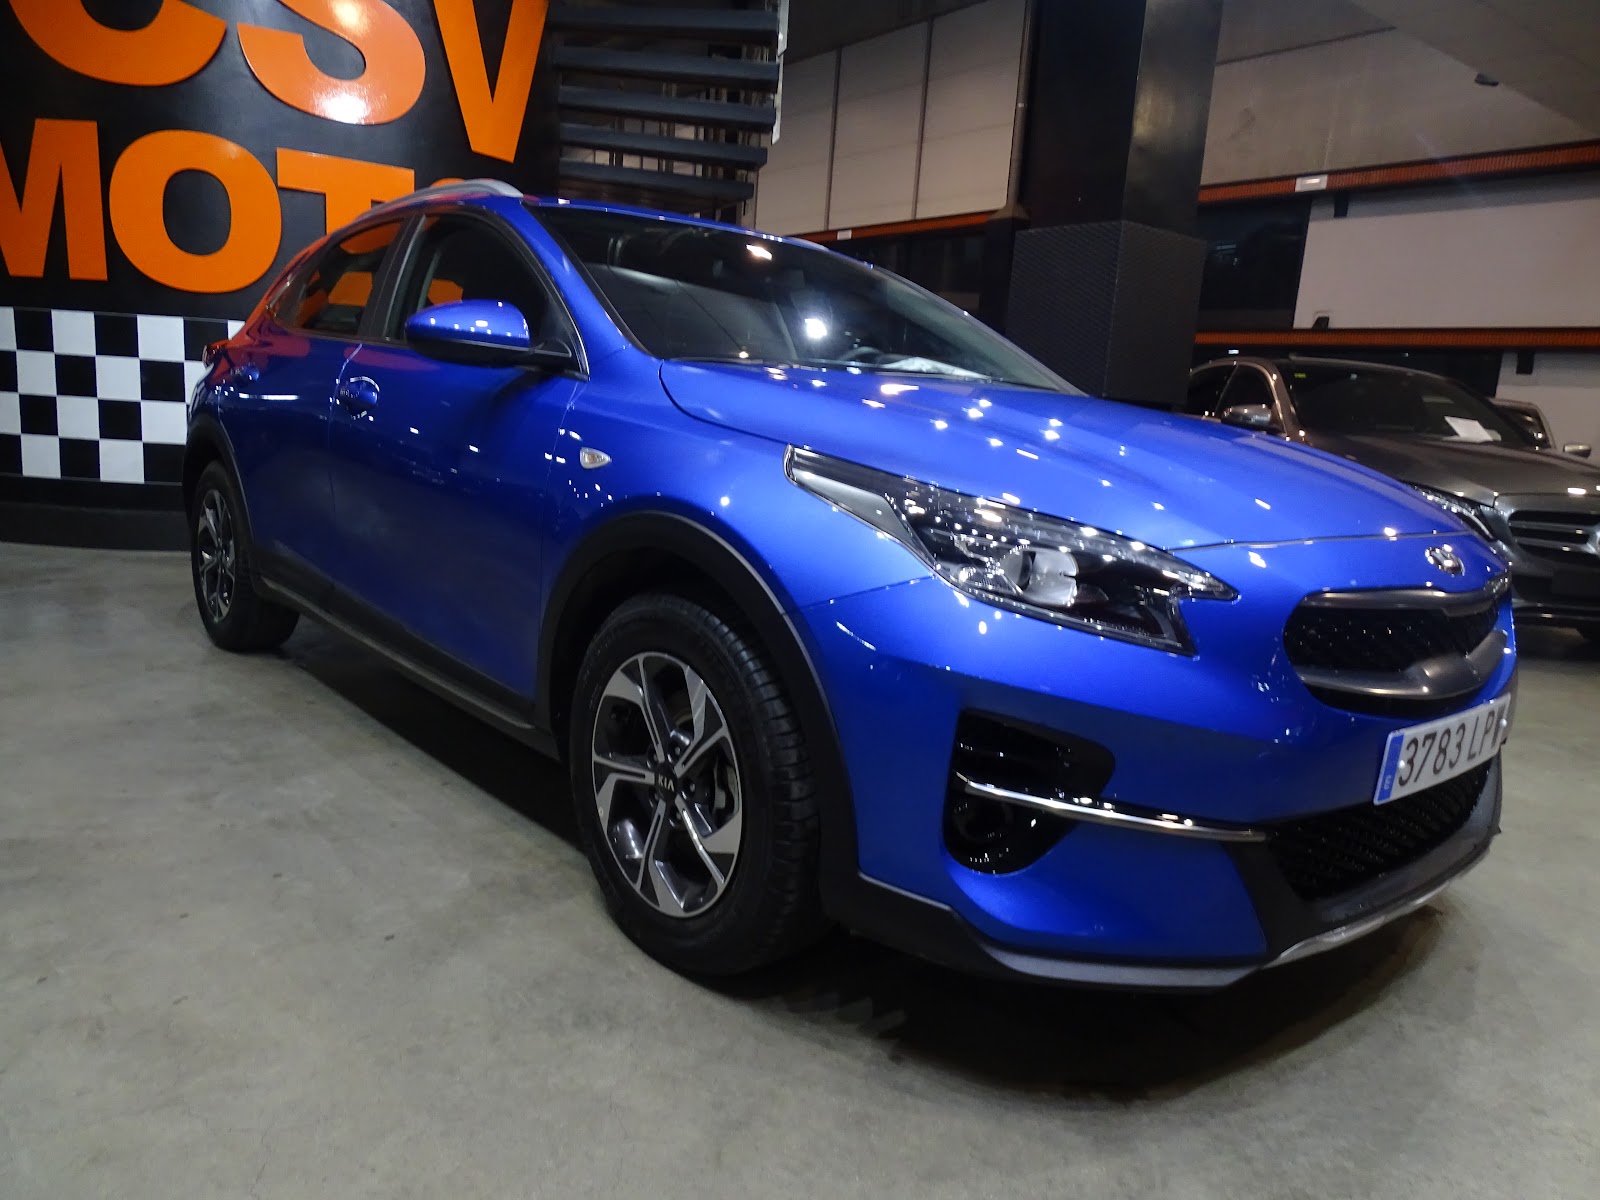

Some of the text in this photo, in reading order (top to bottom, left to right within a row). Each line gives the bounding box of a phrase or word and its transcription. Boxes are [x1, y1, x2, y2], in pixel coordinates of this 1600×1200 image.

[0, 118, 468, 293] MOT
[658, 773, 675, 792] KIA
[1398, 722, 1466, 787] 3783
